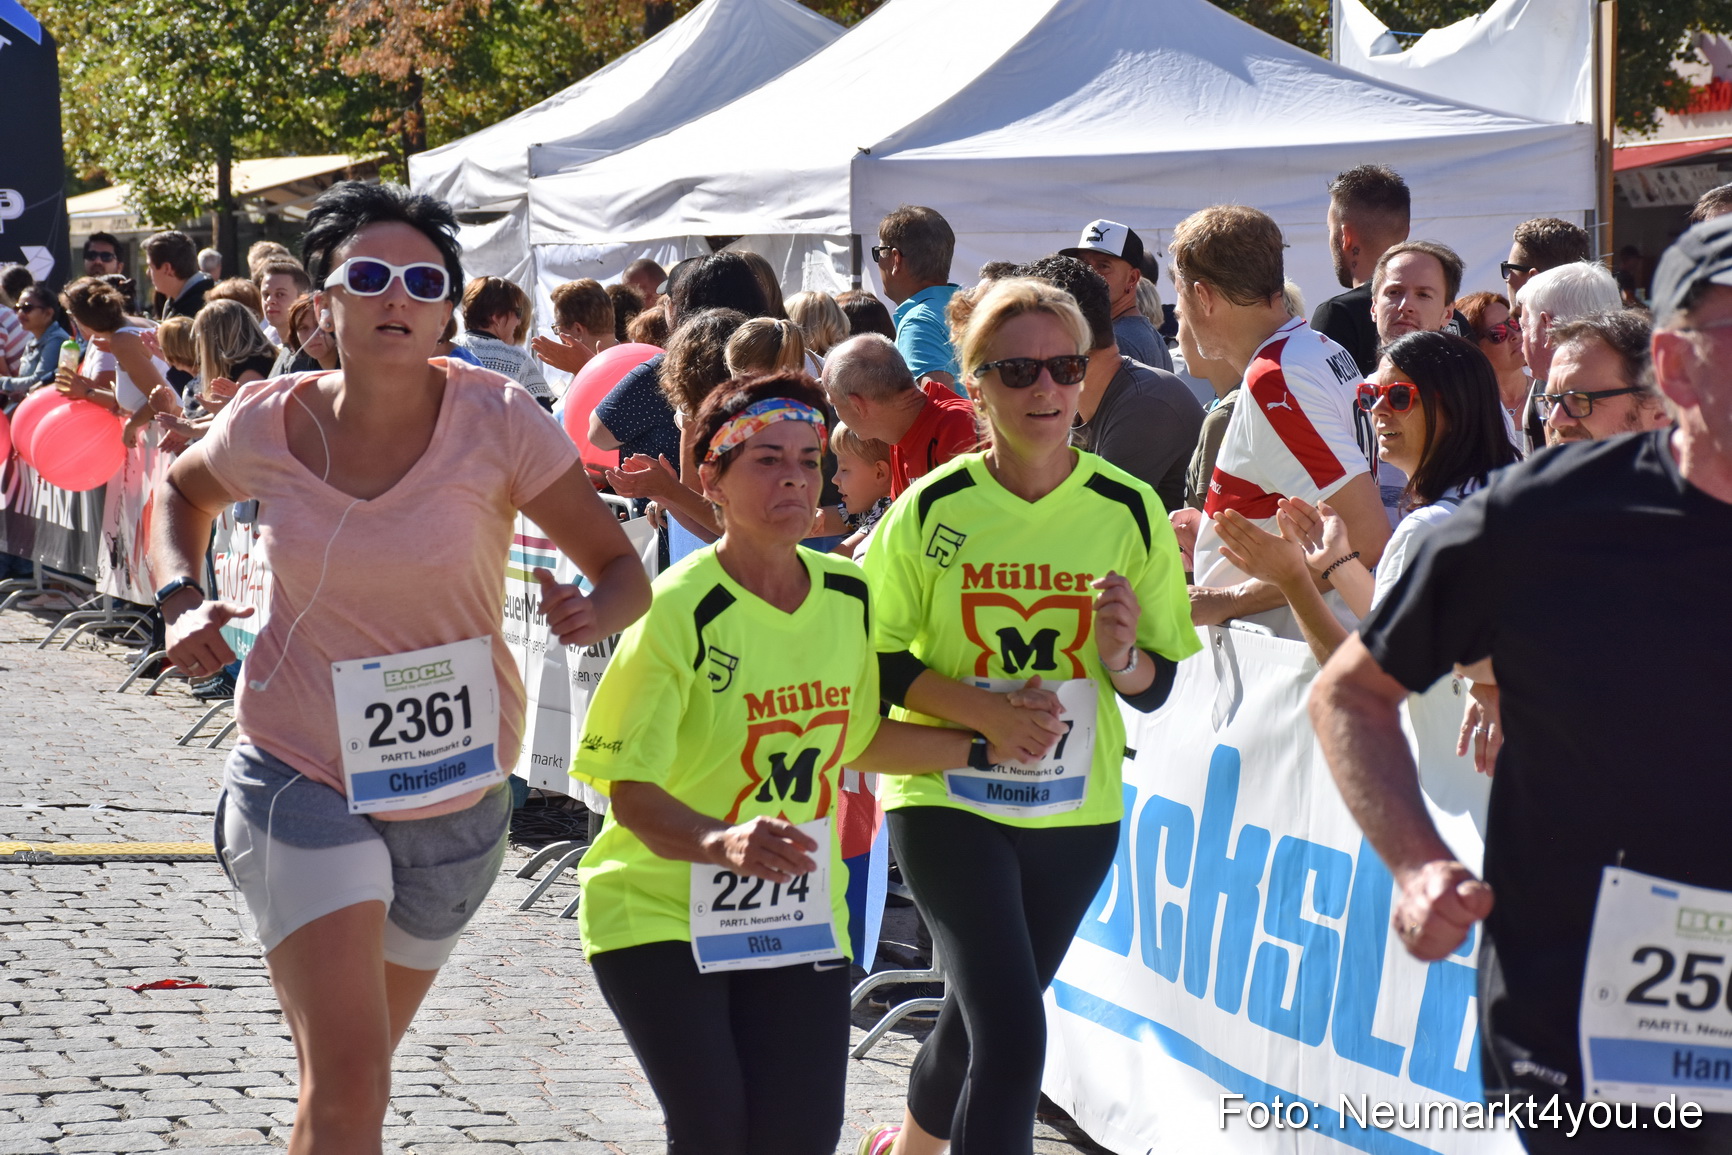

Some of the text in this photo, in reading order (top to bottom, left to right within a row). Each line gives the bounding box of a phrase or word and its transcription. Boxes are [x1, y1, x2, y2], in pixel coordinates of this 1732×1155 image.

[961, 563, 1094, 592] Müller
[995, 627, 1061, 675] M
[384, 659, 454, 688] BOCK
[743, 680, 850, 721] Müller
[364, 684, 472, 749] 2361
[351, 742, 358, 751] D
[381, 740, 460, 763] PARTL Neumarkt
[389, 761, 467, 793] Christine
[755, 747, 821, 803] M
[1009, 766, 1052, 777] Neumarkt
[986, 783, 1051, 803] Monika
[720, 914, 791, 928] PARTL Neumarkt
[747, 935, 782, 954] Rita
[1625, 945, 1732, 1013] 25
[1638, 1017, 1691, 1034] PARTL
[1672, 1050, 1732, 1082] Han
